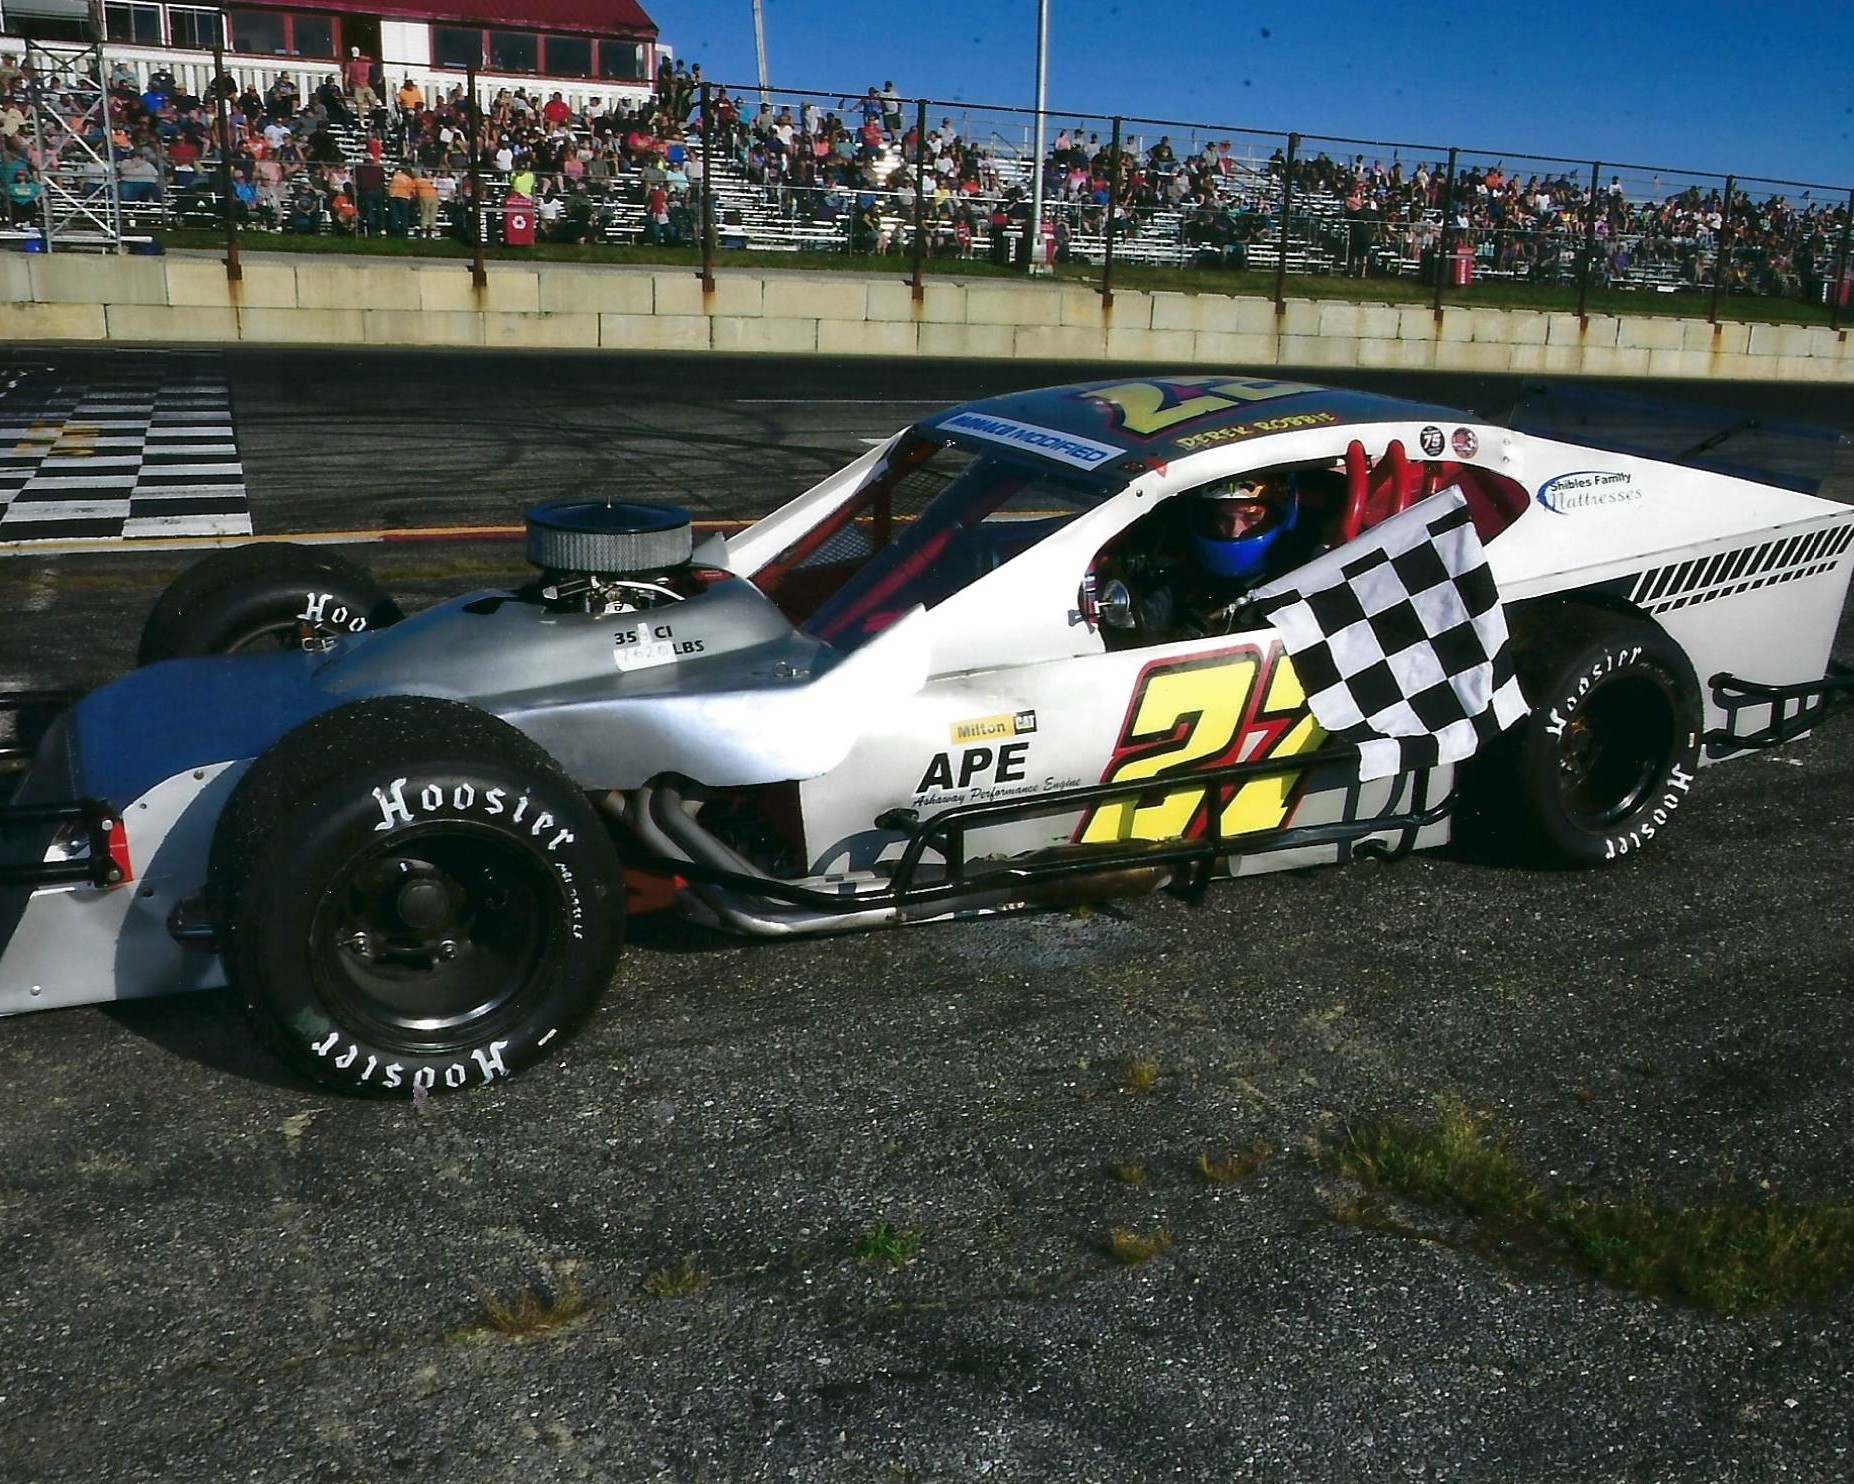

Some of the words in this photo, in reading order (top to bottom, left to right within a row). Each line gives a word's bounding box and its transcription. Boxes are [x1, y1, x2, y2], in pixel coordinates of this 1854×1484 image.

[1007, 429, 1108, 462] MODIFIED
[1175, 425, 1251, 449] DEREK
[1253, 411, 1336, 431] ROBBIE
[1423, 432, 1441, 449] 75
[1550, 478, 1592, 492] Shibles
[1594, 472, 1632, 485] Family
[296, 592, 367, 632] Hoo
[654, 625, 673, 639] CI
[673, 640, 705, 655] LBS
[1545, 645, 1643, 744] Hoosier
[957, 722, 1006, 739] Milton
[915, 741, 1030, 794] APE
[970, 784, 1039, 801] Performance
[1043, 776, 1082, 790] Engine
[371, 777, 575, 850] Hoosier
[1604, 762, 1694, 860] Hoosier
[311, 1032, 510, 1089] Hoosier
